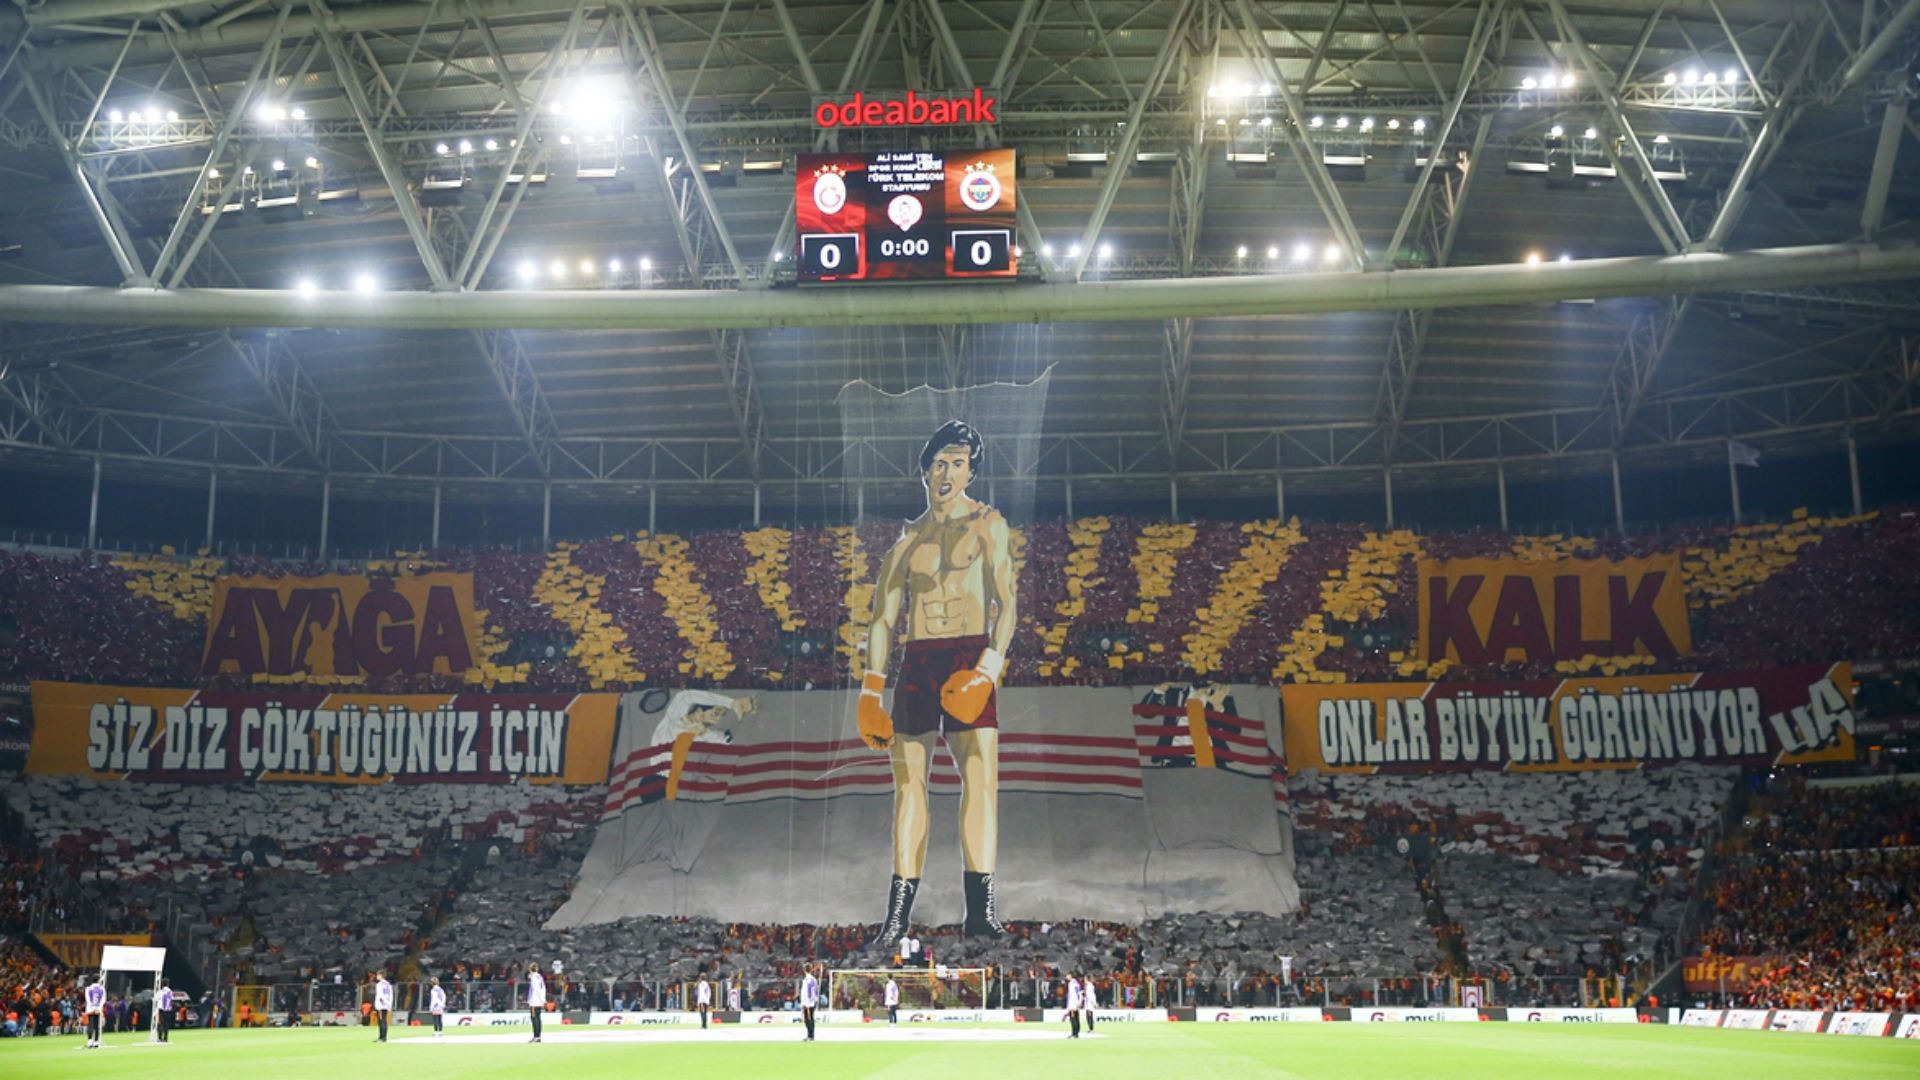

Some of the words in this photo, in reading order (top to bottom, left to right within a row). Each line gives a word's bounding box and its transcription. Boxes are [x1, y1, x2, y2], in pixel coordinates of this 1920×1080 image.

[815, 88, 995, 127] odeabank
[820, 244, 841, 268] 0
[881, 239, 929, 256] 0:00
[971, 240, 992, 265] 0
[1428, 571, 1680, 667] KALK
[87, 697, 152, 770] SİZ
[162, 700, 228, 770] DİZ
[239, 701, 480, 777] ÇÖKTÜĞÜNÜZ
[489, 703, 565, 784] İÇİN
[1319, 698, 1431, 764] ONLAR
[1435, 690, 1553, 762] BÜYÜK
[1559, 684, 1768, 760] GÖRÜNÜYOR
